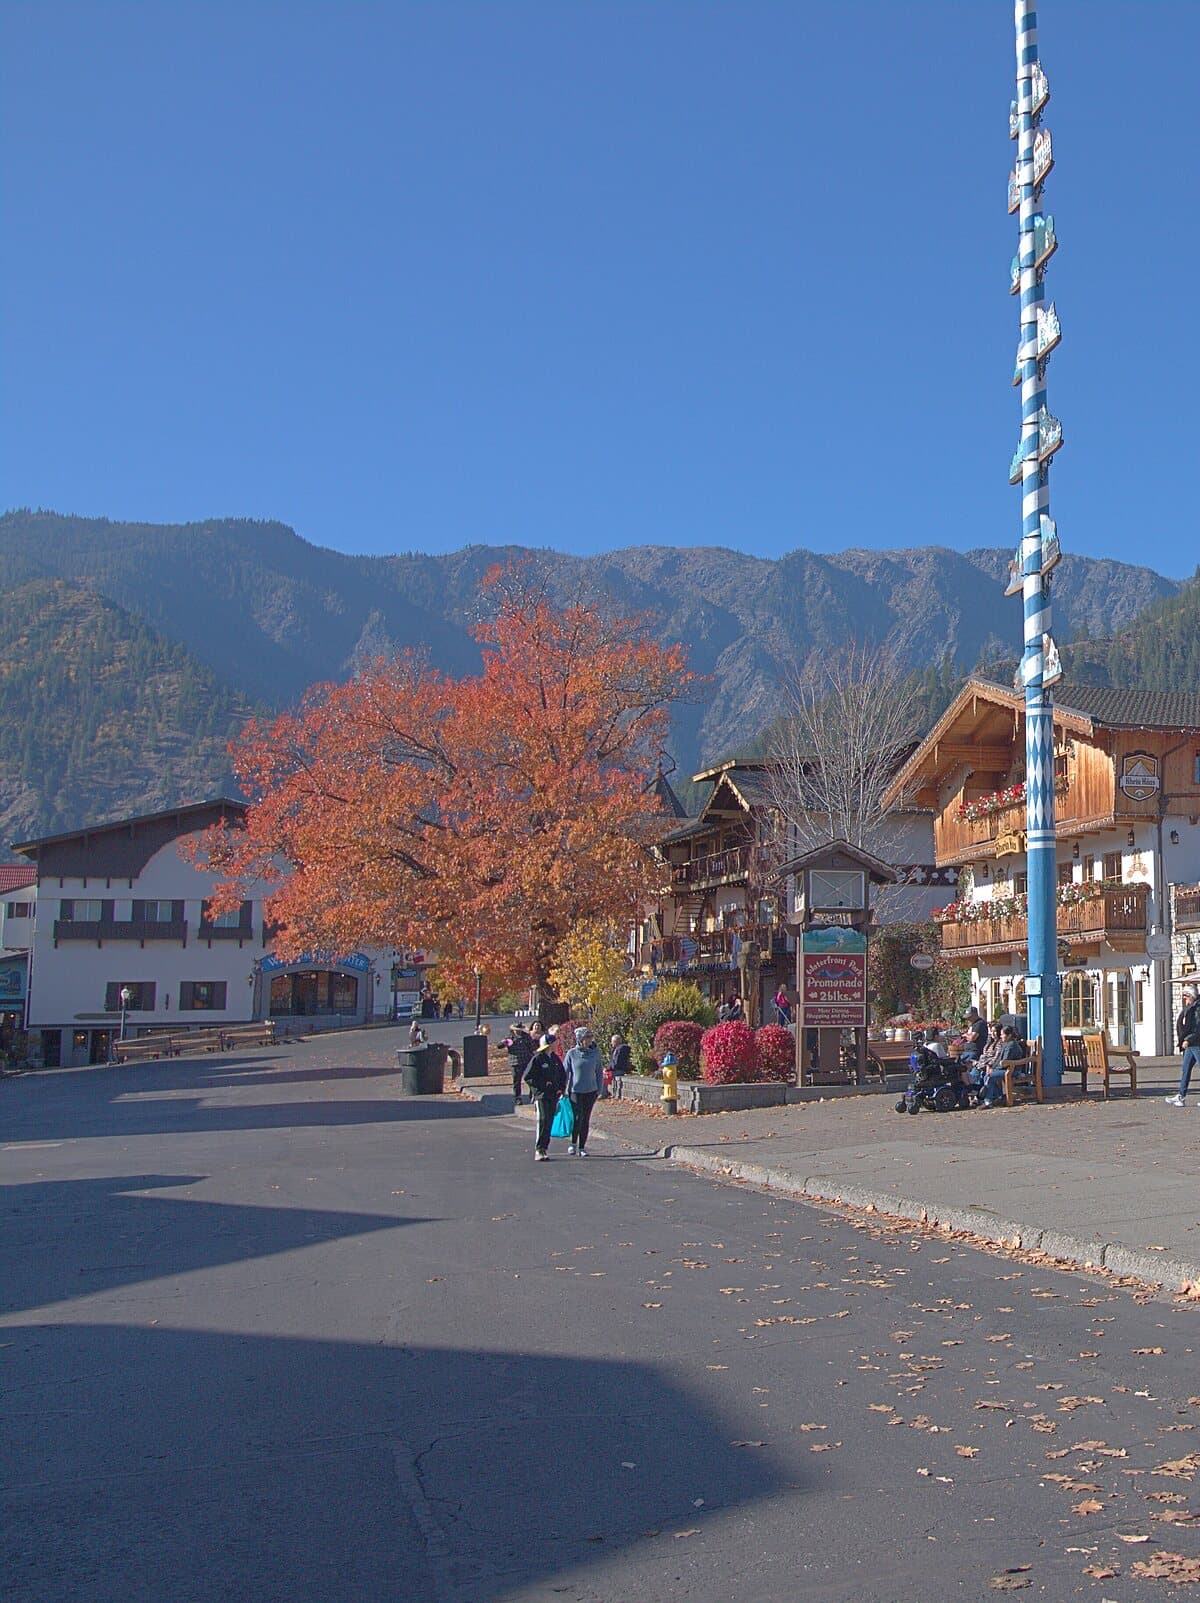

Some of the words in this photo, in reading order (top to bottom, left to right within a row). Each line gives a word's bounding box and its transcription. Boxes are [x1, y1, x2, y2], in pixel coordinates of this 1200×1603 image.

[806, 956, 847, 975] Waterfront
[848, 959, 864, 976] Park
[807, 977, 863, 988] Promenade
